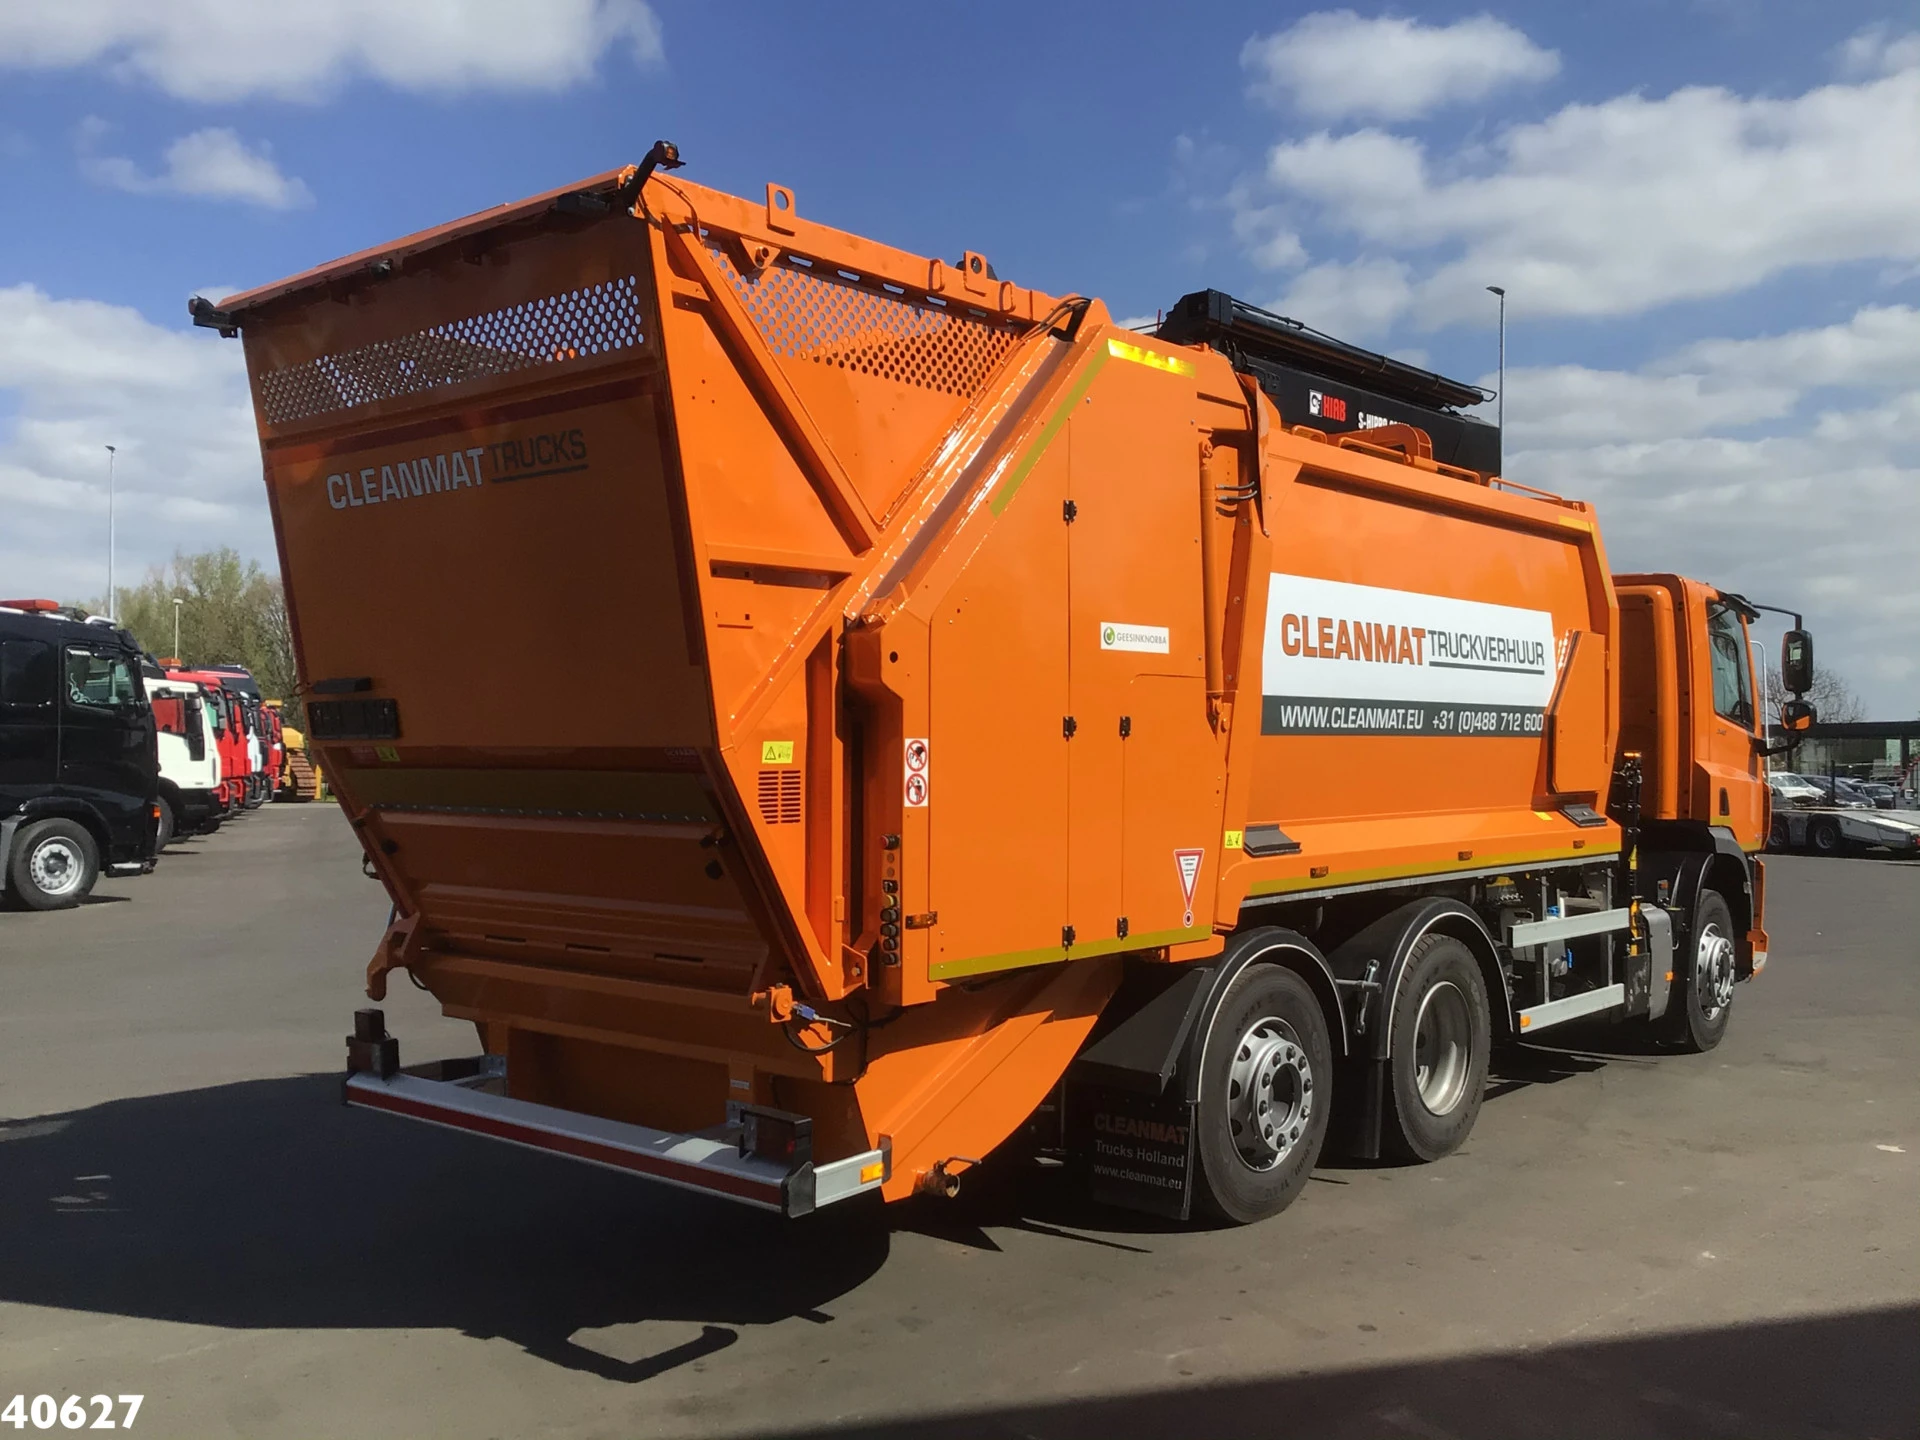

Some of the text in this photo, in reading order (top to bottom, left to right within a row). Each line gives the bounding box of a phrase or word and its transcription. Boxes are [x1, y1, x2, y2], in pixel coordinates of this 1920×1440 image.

[1323, 395, 1346, 422] HIAB
[326, 429, 587, 509] CLEANMAT TRUCKS
[1116, 632, 1167, 644] GEESINKNORBA
[1281, 613, 1545, 666] CLEANMAT TRUCKVERHUUR
[1280, 705, 1544, 733] WWW.CLEANMAT.EU +31 (0)488 712 600
[1094, 1112, 1188, 1146] CLEANMAT
[1095, 1139, 1185, 1168] Trucks Holland
[1093, 1163, 1183, 1190] www.cleanmat.eu
